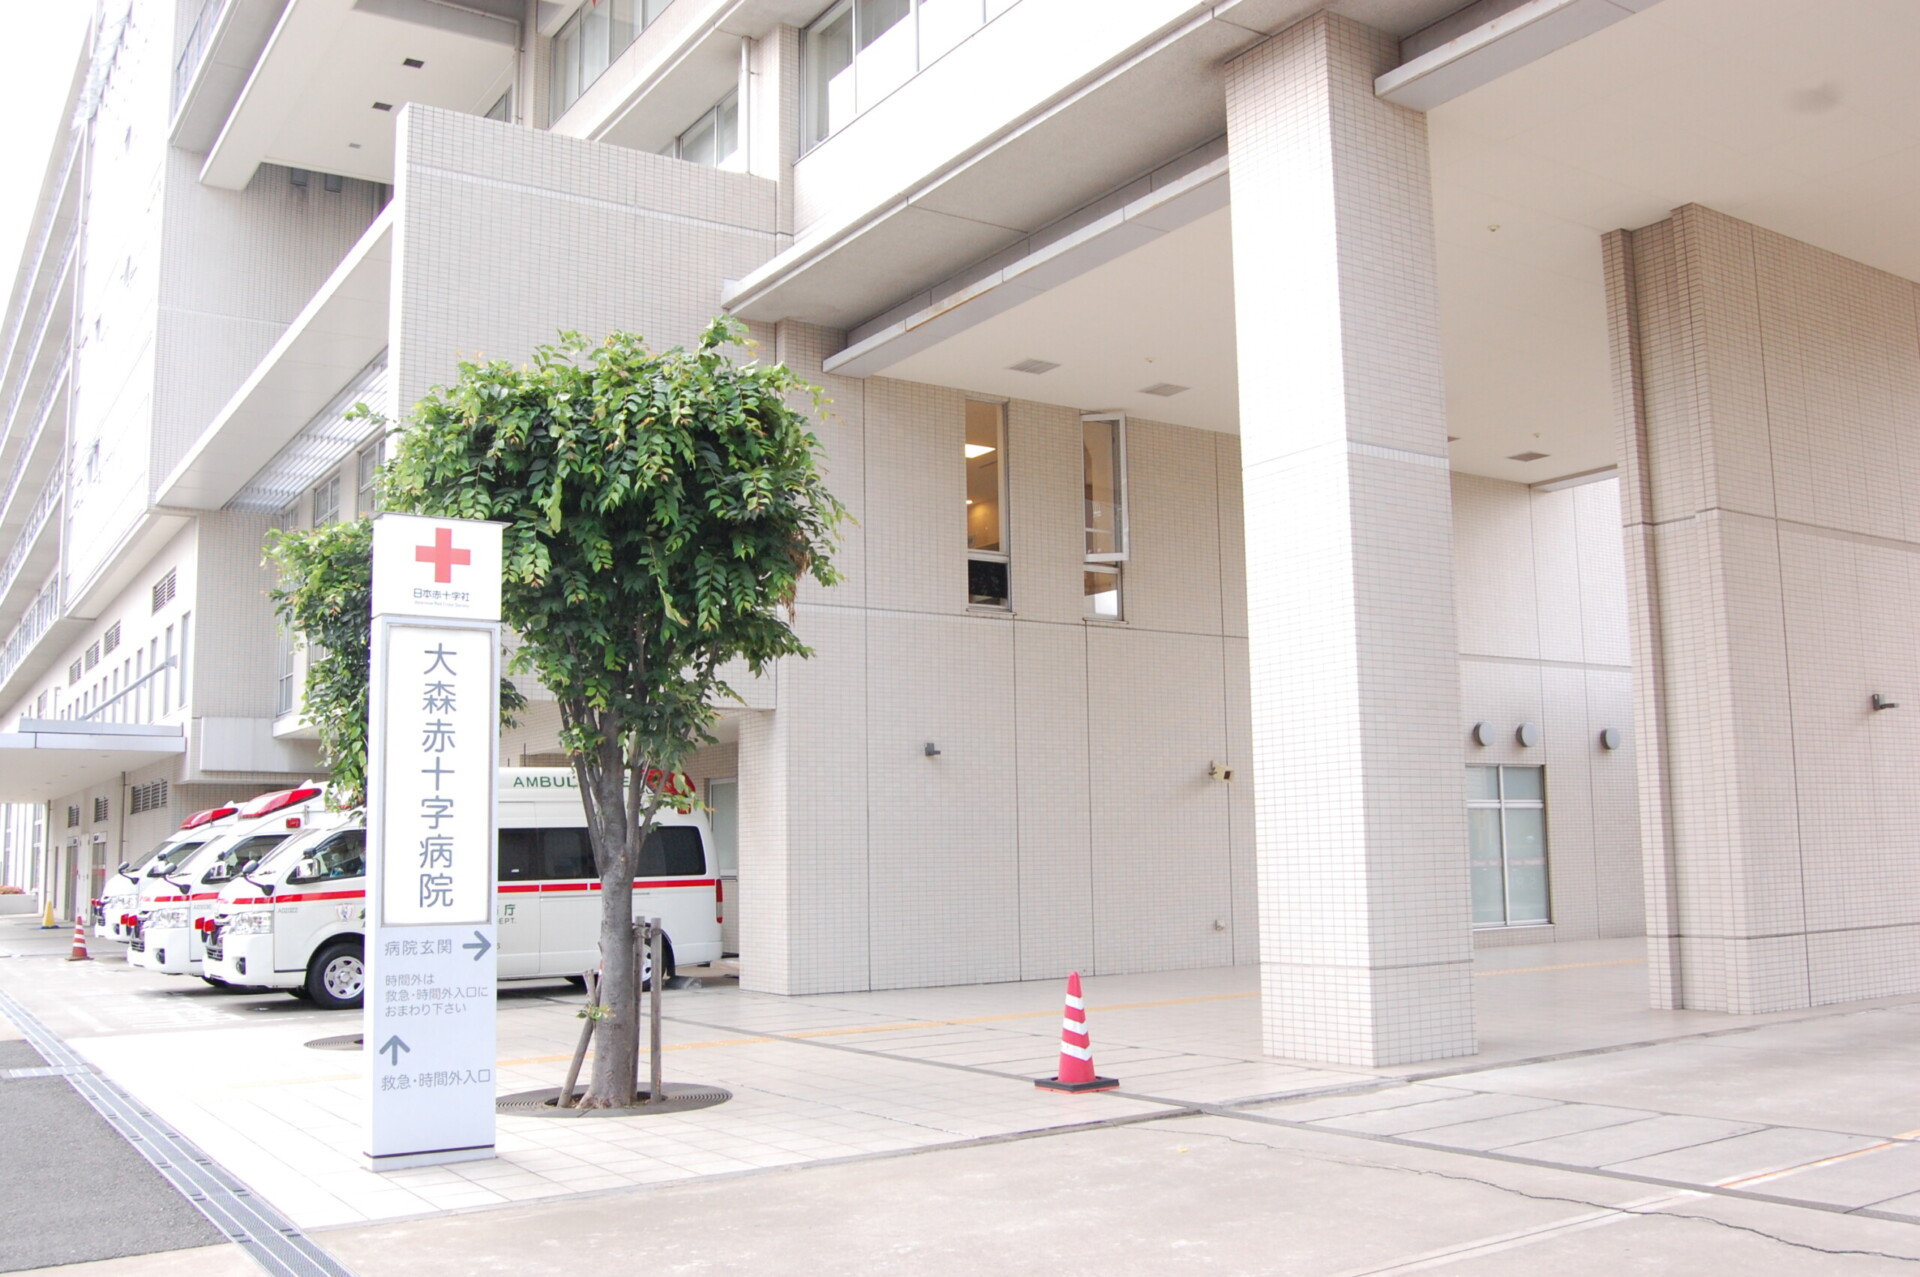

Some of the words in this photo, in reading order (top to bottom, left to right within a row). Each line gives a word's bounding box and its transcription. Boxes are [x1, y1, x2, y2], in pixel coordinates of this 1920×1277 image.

[413, 587, 470, 602] 日本赤十字社
[419, 642, 457, 908] 大森赤十字病院
[513, 775, 632, 788] AMBULE
[384, 939, 452, 957] 病院玄関
[385, 974, 434, 987] 時間外は
[385, 986, 489, 1004] 救急・時間外入口に
[385, 1002, 467, 1018] おまわり下さい
[381, 1069, 491, 1092] 救急・時間外入口
